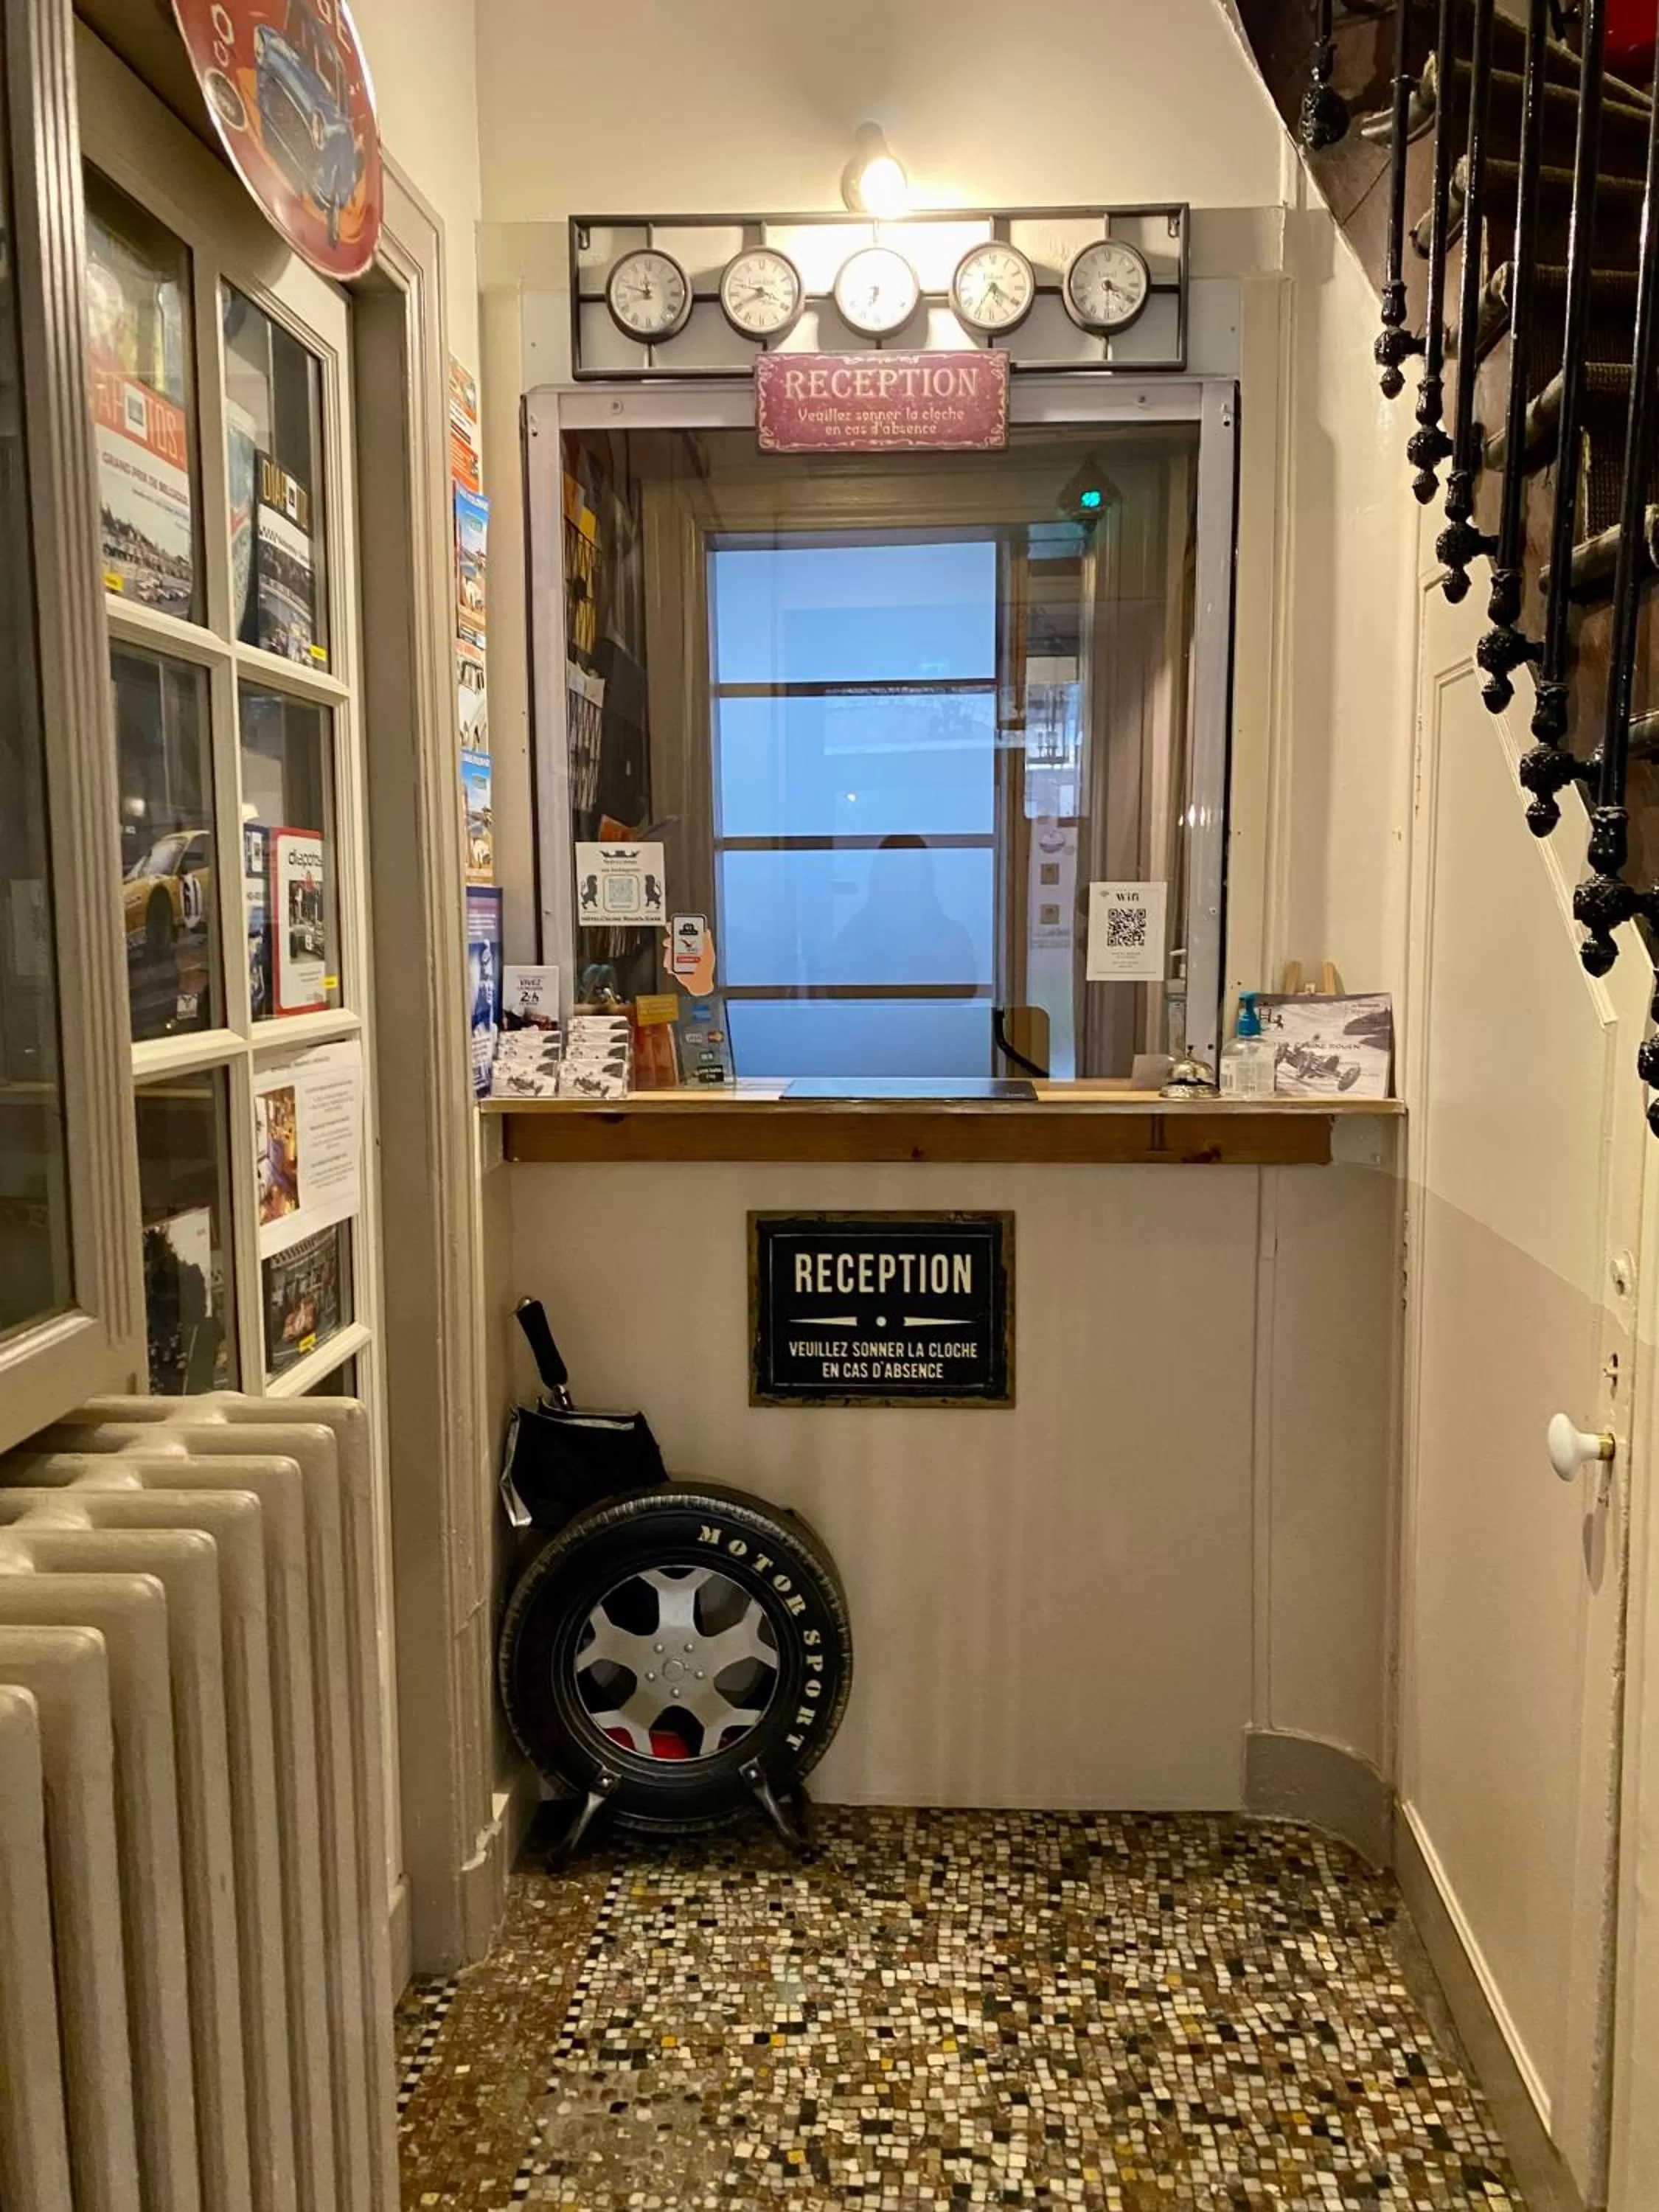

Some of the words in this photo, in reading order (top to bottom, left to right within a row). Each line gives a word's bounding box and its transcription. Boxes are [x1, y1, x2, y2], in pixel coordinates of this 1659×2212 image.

[785, 368, 978, 400] RECEPTION
[798, 408, 849, 422] Veuillez
[855, 410, 902, 422] sonner
[905, 408, 918, 422] la
[922, 408, 965, 422] cloche
[825, 426, 841, 436] en
[844, 425, 866, 436] cas
[871, 422, 937, 436] d'absence
[795, 1253, 973, 1294] RECEPTION
[789, 1341, 848, 1357] VEUILLEZ
[852, 1341, 905, 1358] SONNER
[908, 1342, 925, 1358] LA
[928, 1342, 978, 1358] CLOCHE
[822, 1363, 839, 1379] EN
[843, 1362, 869, 1379] CAS
[872, 1360, 944, 1379] D'ABSENCE
